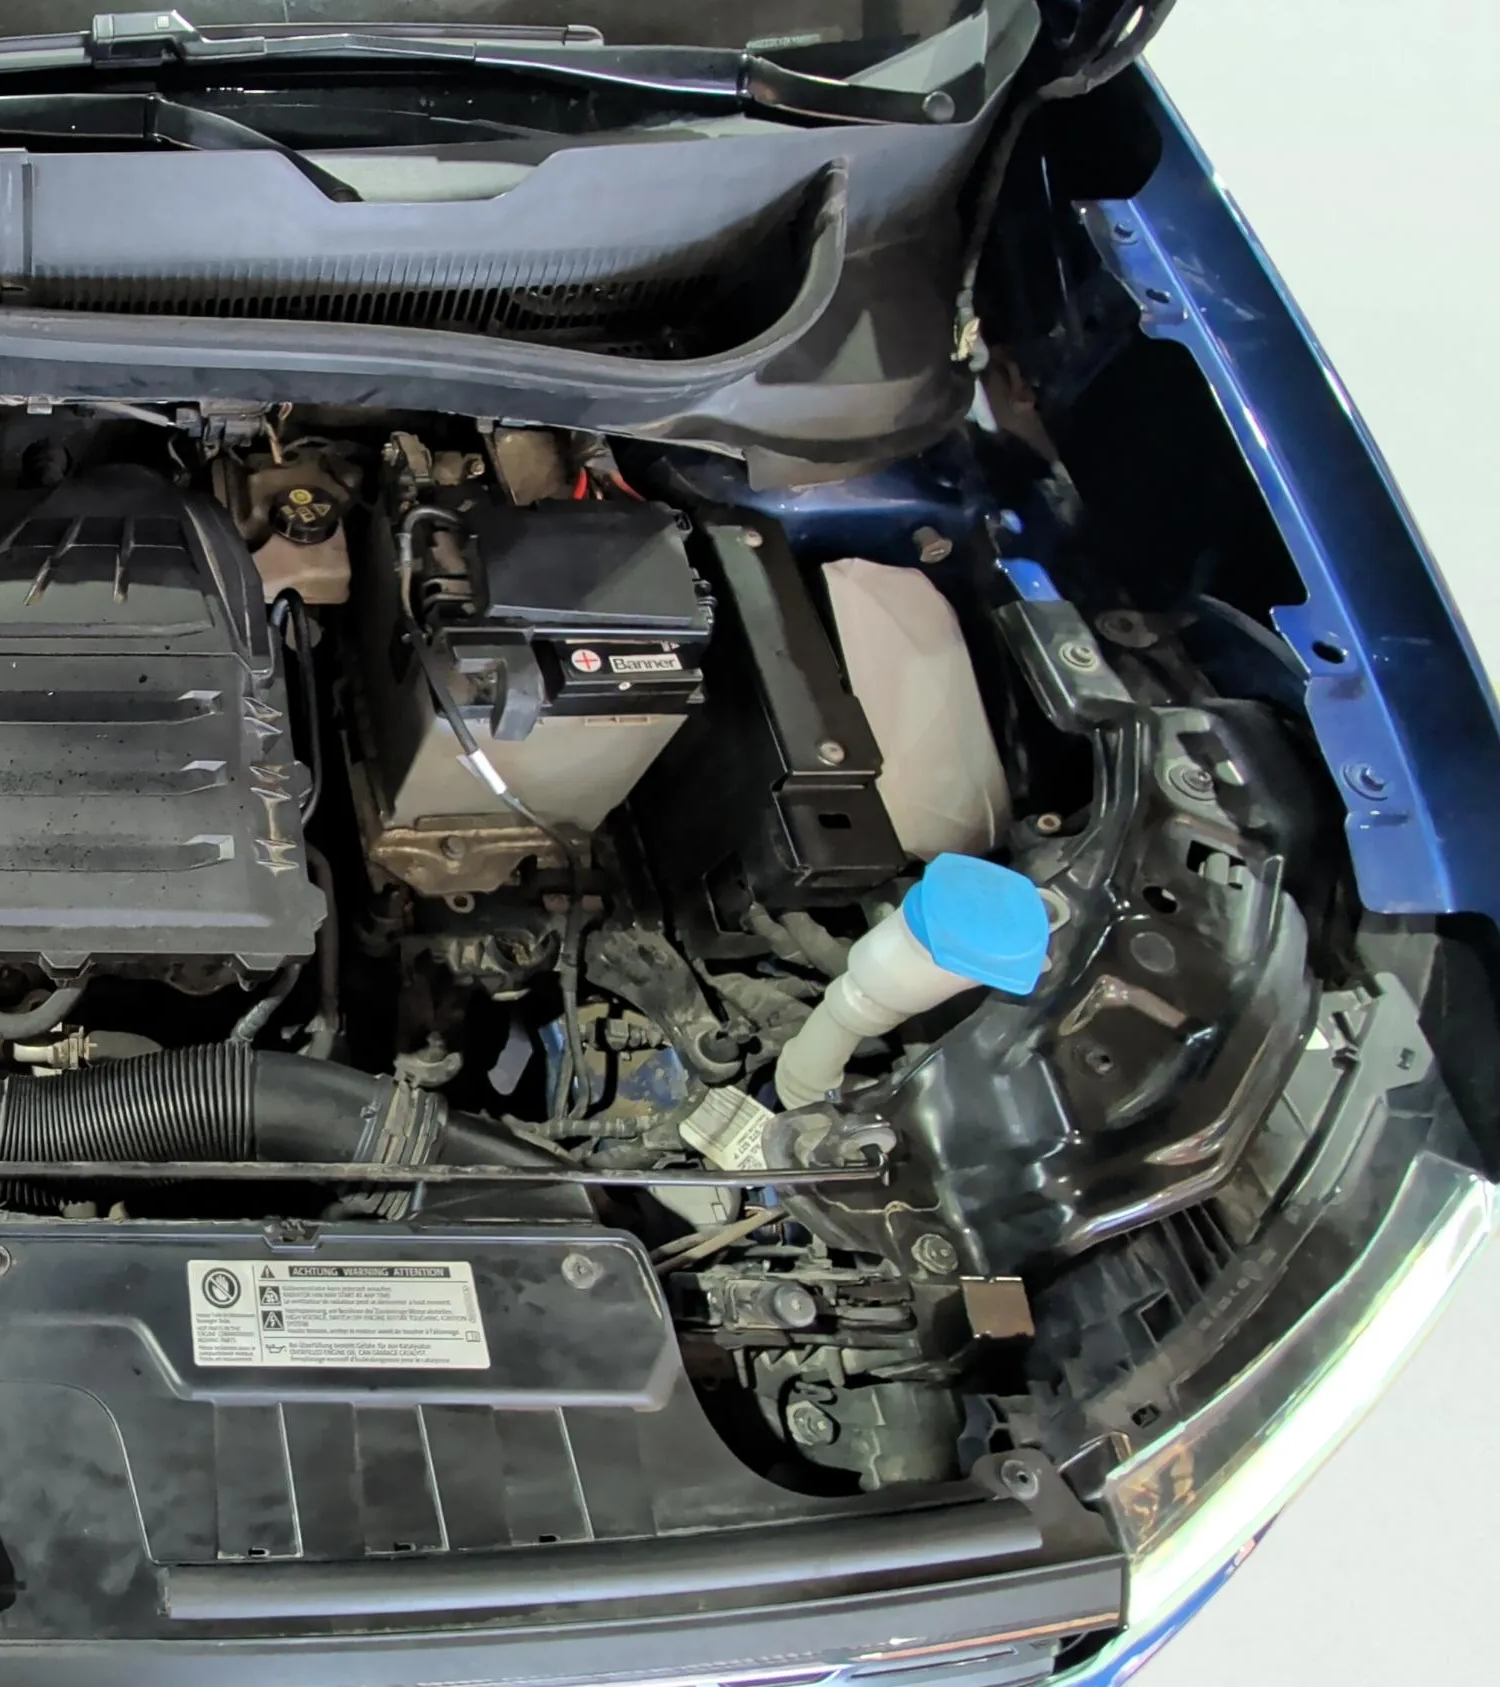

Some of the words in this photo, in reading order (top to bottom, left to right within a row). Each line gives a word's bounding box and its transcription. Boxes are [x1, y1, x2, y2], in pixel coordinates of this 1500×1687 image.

[612, 657, 676, 671] Banner
[291, 1267, 339, 1276] ACHTUNG
[343, 1267, 389, 1277] WARNING
[393, 1267, 445, 1277] ATTENTION
